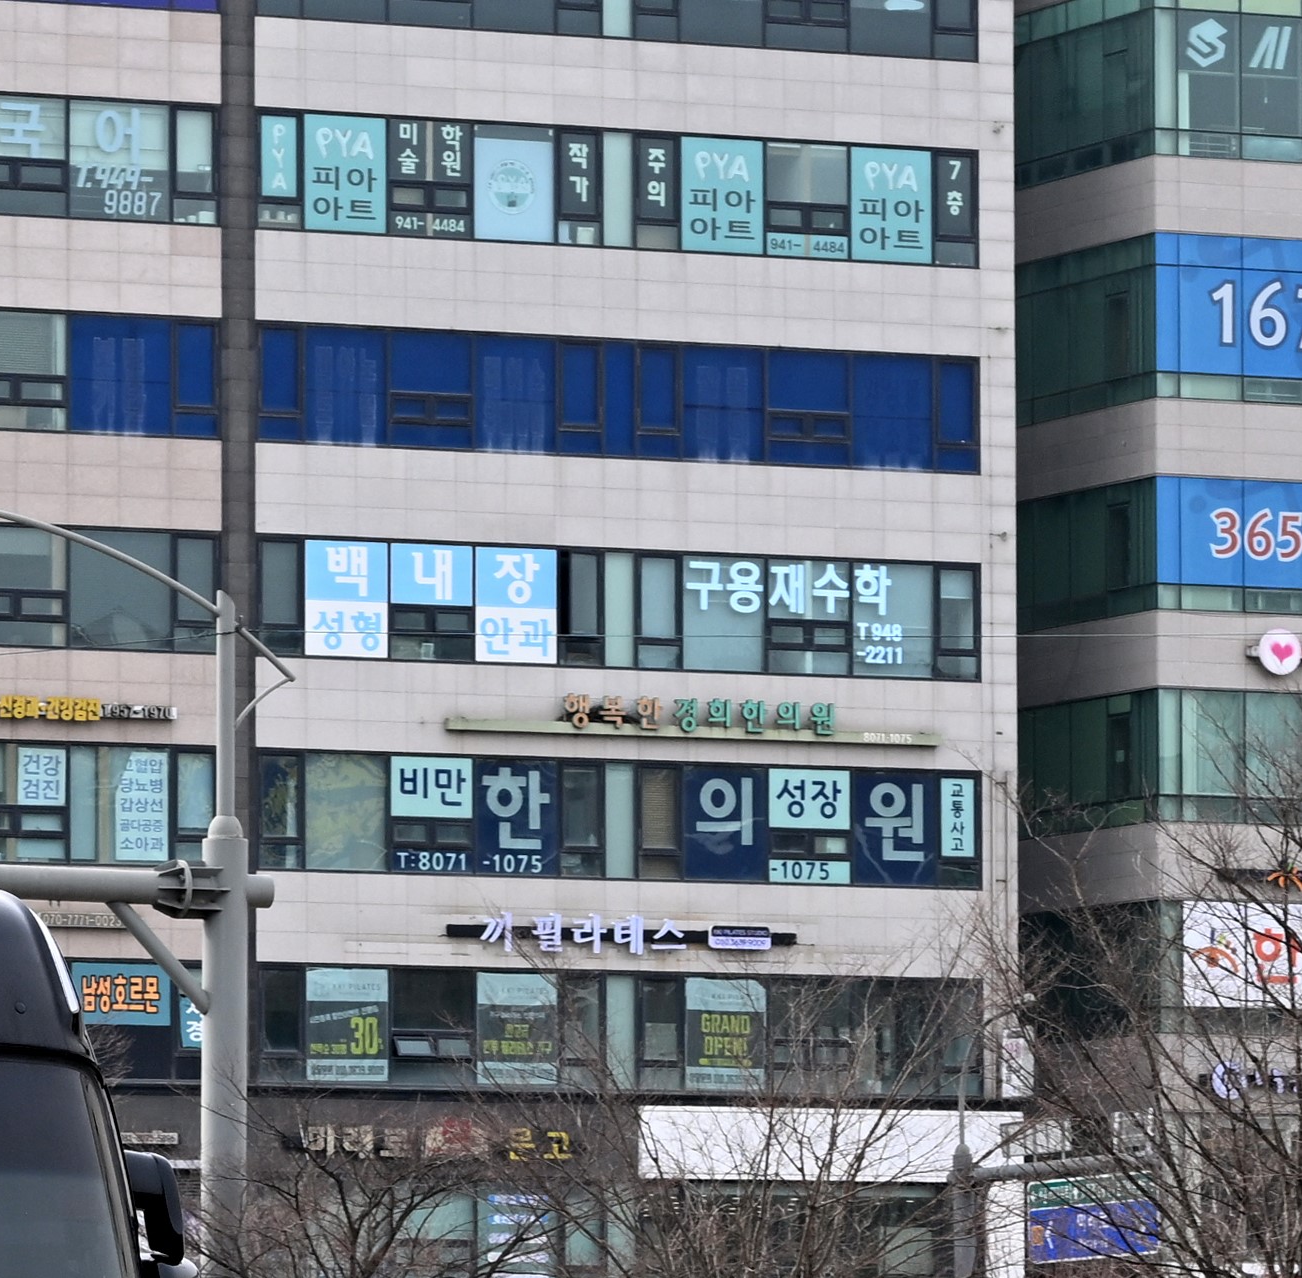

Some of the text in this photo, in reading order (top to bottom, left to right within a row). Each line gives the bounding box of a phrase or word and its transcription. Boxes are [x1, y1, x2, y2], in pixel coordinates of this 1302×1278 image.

[270, 123, 288, 192] PYA
[314, 127, 375, 162] PYA
[397, 121, 464, 179] 미술 학원
[310, 165, 380, 194] 피아
[568, 142, 590, 203] 작가
[647, 147, 668, 209] 주의
[694, 149, 751, 184] PYA
[863, 161, 920, 194] PYA
[103, 190, 163, 217] 9887
[688, 186, 757, 214] 피아
[947, 158, 964, 217] 7층
[311, 196, 379, 223] 아트
[858, 197, 926, 225] 피아
[689, 216, 757, 243] 아트
[859, 226, 926, 252] 아트
[1209, 278, 1302, 352] 16
[326, 546, 541, 605] 백내장
[313, 608, 383, 652] 성형
[482, 615, 555, 659] 안과
[856, 645, 904, 667] -2211
[23, 754, 62, 777] 건강
[398, 756, 467, 808] 비만
[22, 779, 61, 801] 검진
[120, 796, 164, 814] 갑상선
[776, 778, 842, 820] 성장
[950, 782, 966, 853] 교통사고
[119, 836, 165, 852] 소아과
[770, 861, 831, 881] -1075
[531, 911, 688, 956] 필라테스
[81, 974, 162, 1013] 남성호르몬
[349, 1016, 379, 1056] 30
[700, 1013, 752, 1034] GRAND
